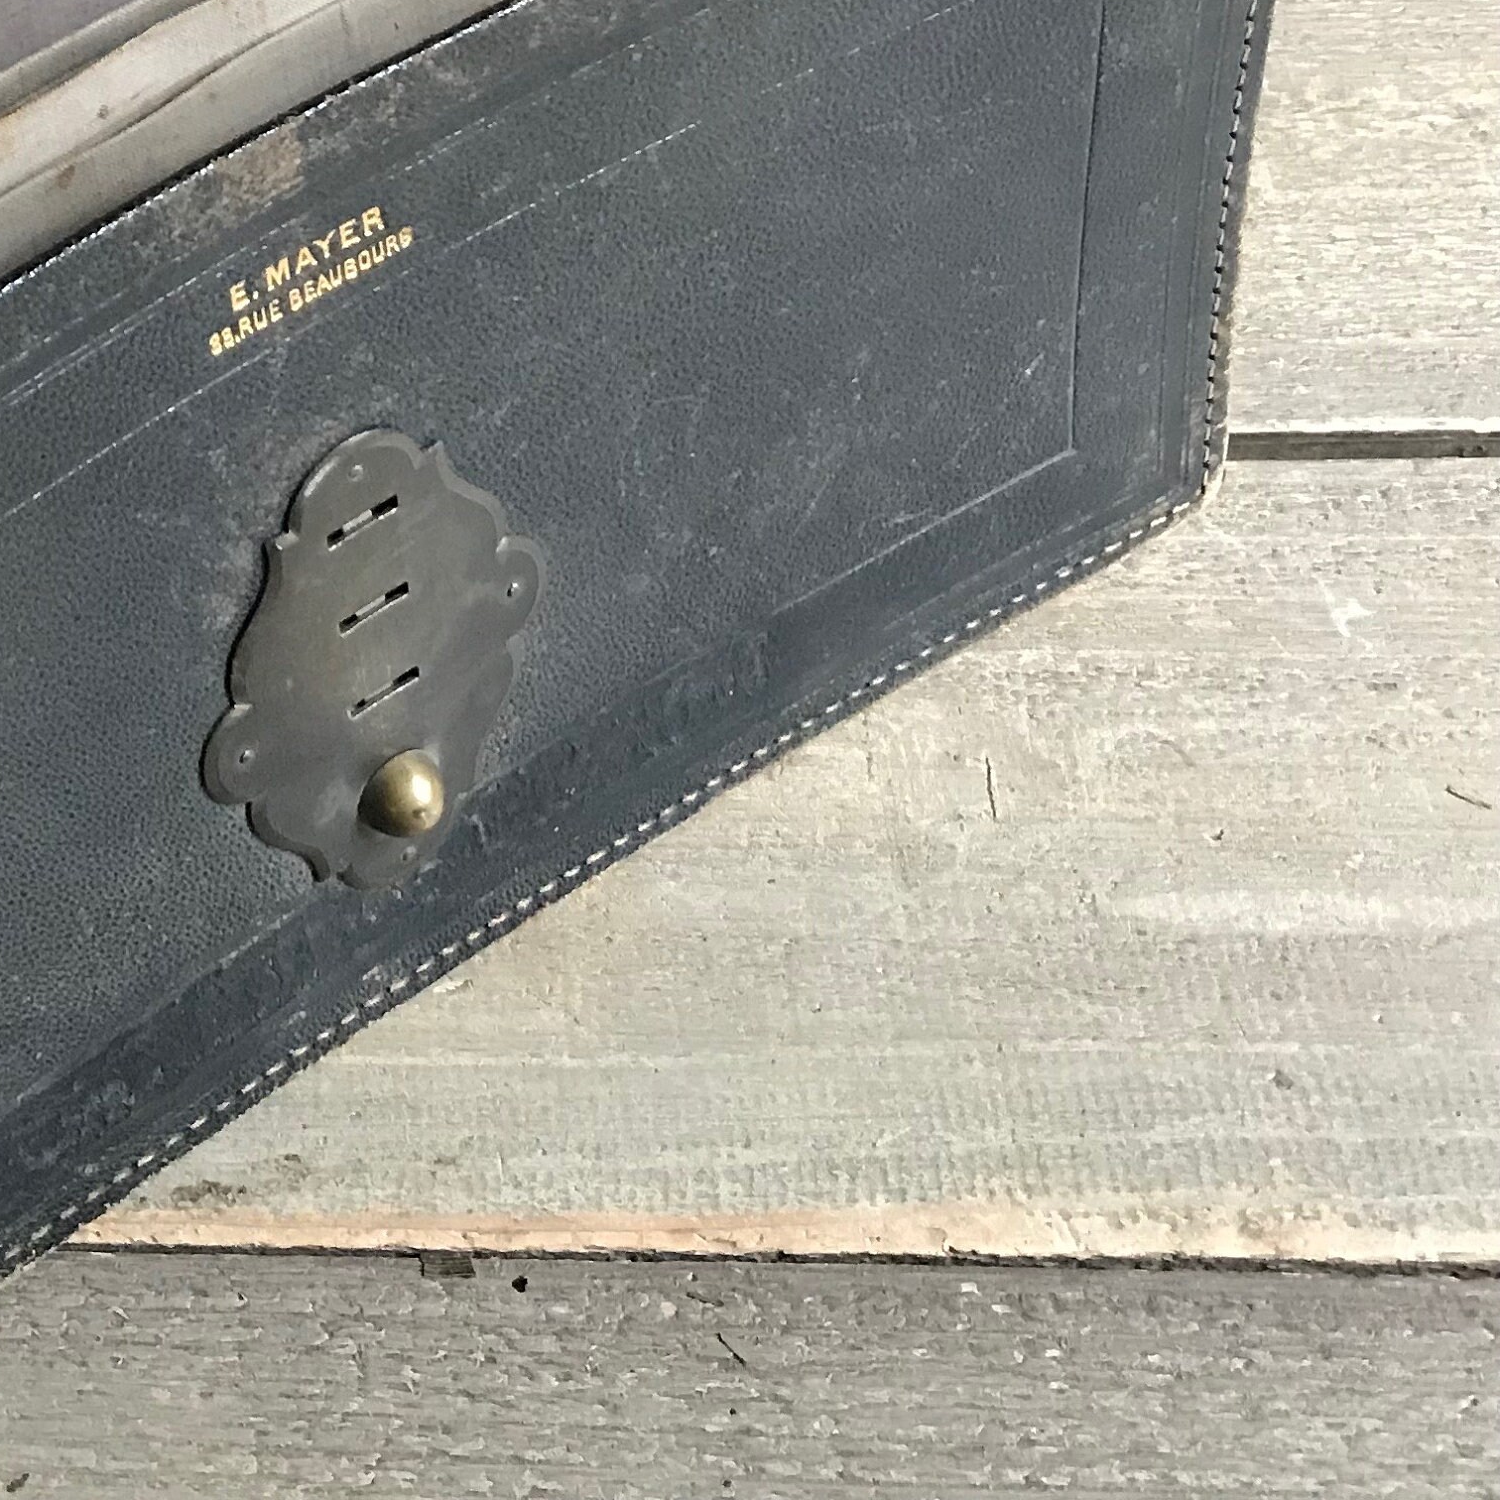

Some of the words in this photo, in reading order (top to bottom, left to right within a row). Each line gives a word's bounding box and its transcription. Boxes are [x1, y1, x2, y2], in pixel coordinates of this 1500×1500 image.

[228, 278, 260, 313] E.
[264, 205, 386, 293] MAYER
[288, 225, 414, 313] BEAUBOURG
